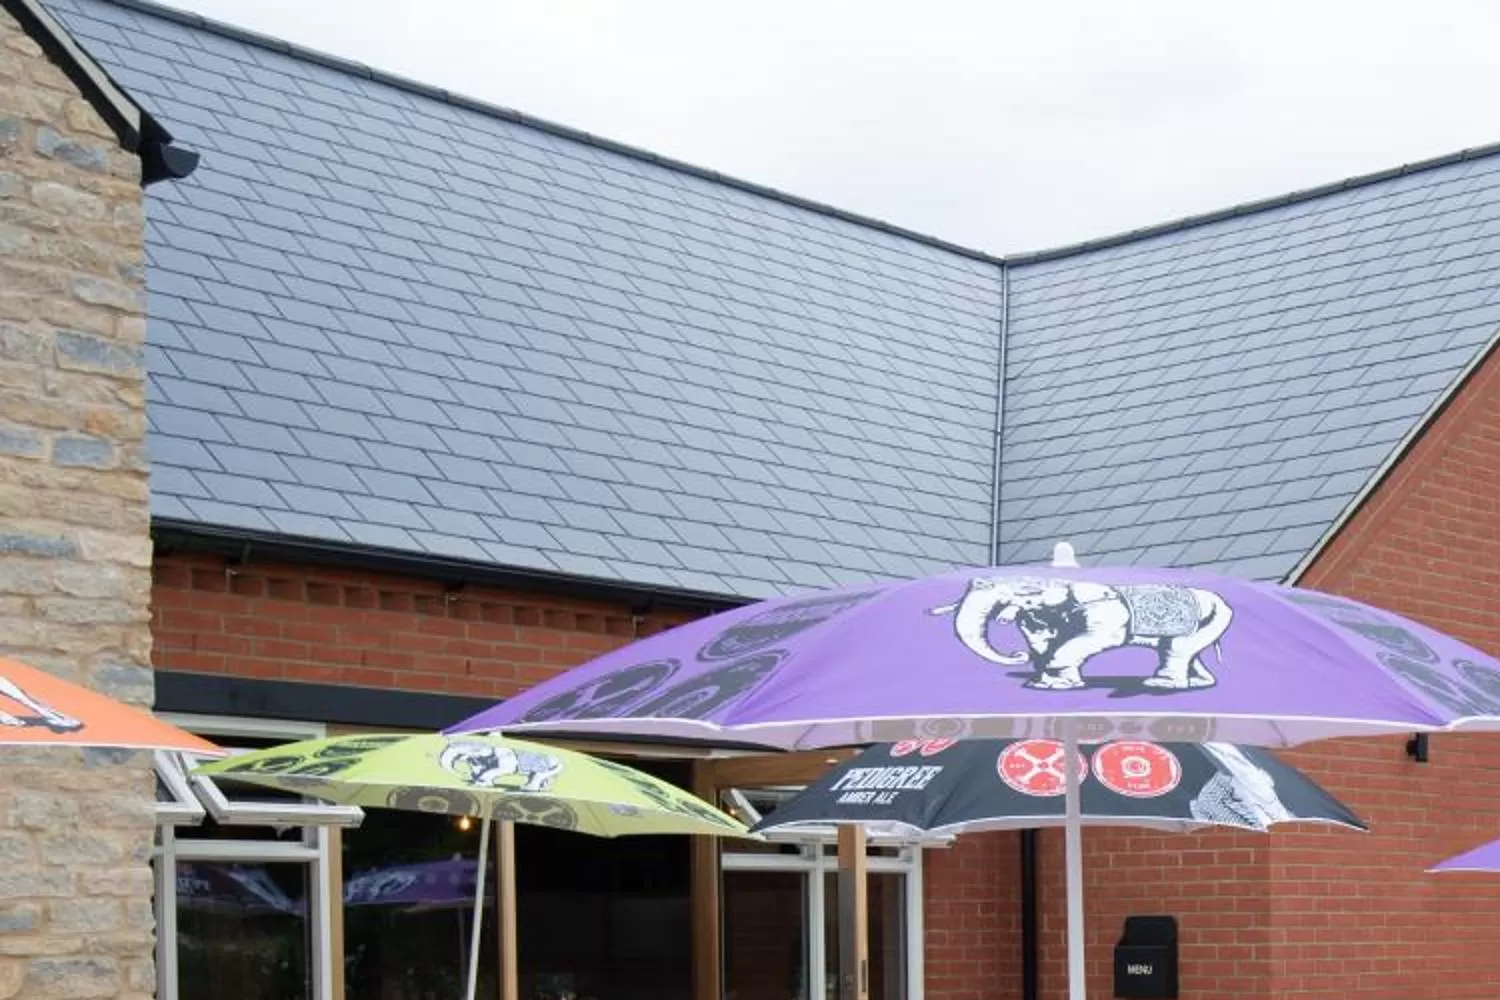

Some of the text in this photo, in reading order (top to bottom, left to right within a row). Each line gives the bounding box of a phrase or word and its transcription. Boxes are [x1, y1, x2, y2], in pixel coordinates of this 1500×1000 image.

[829, 766, 944, 791] PEDIGREE
[872, 791, 900, 805] ALE
[1127, 964, 1153, 975] MENU
